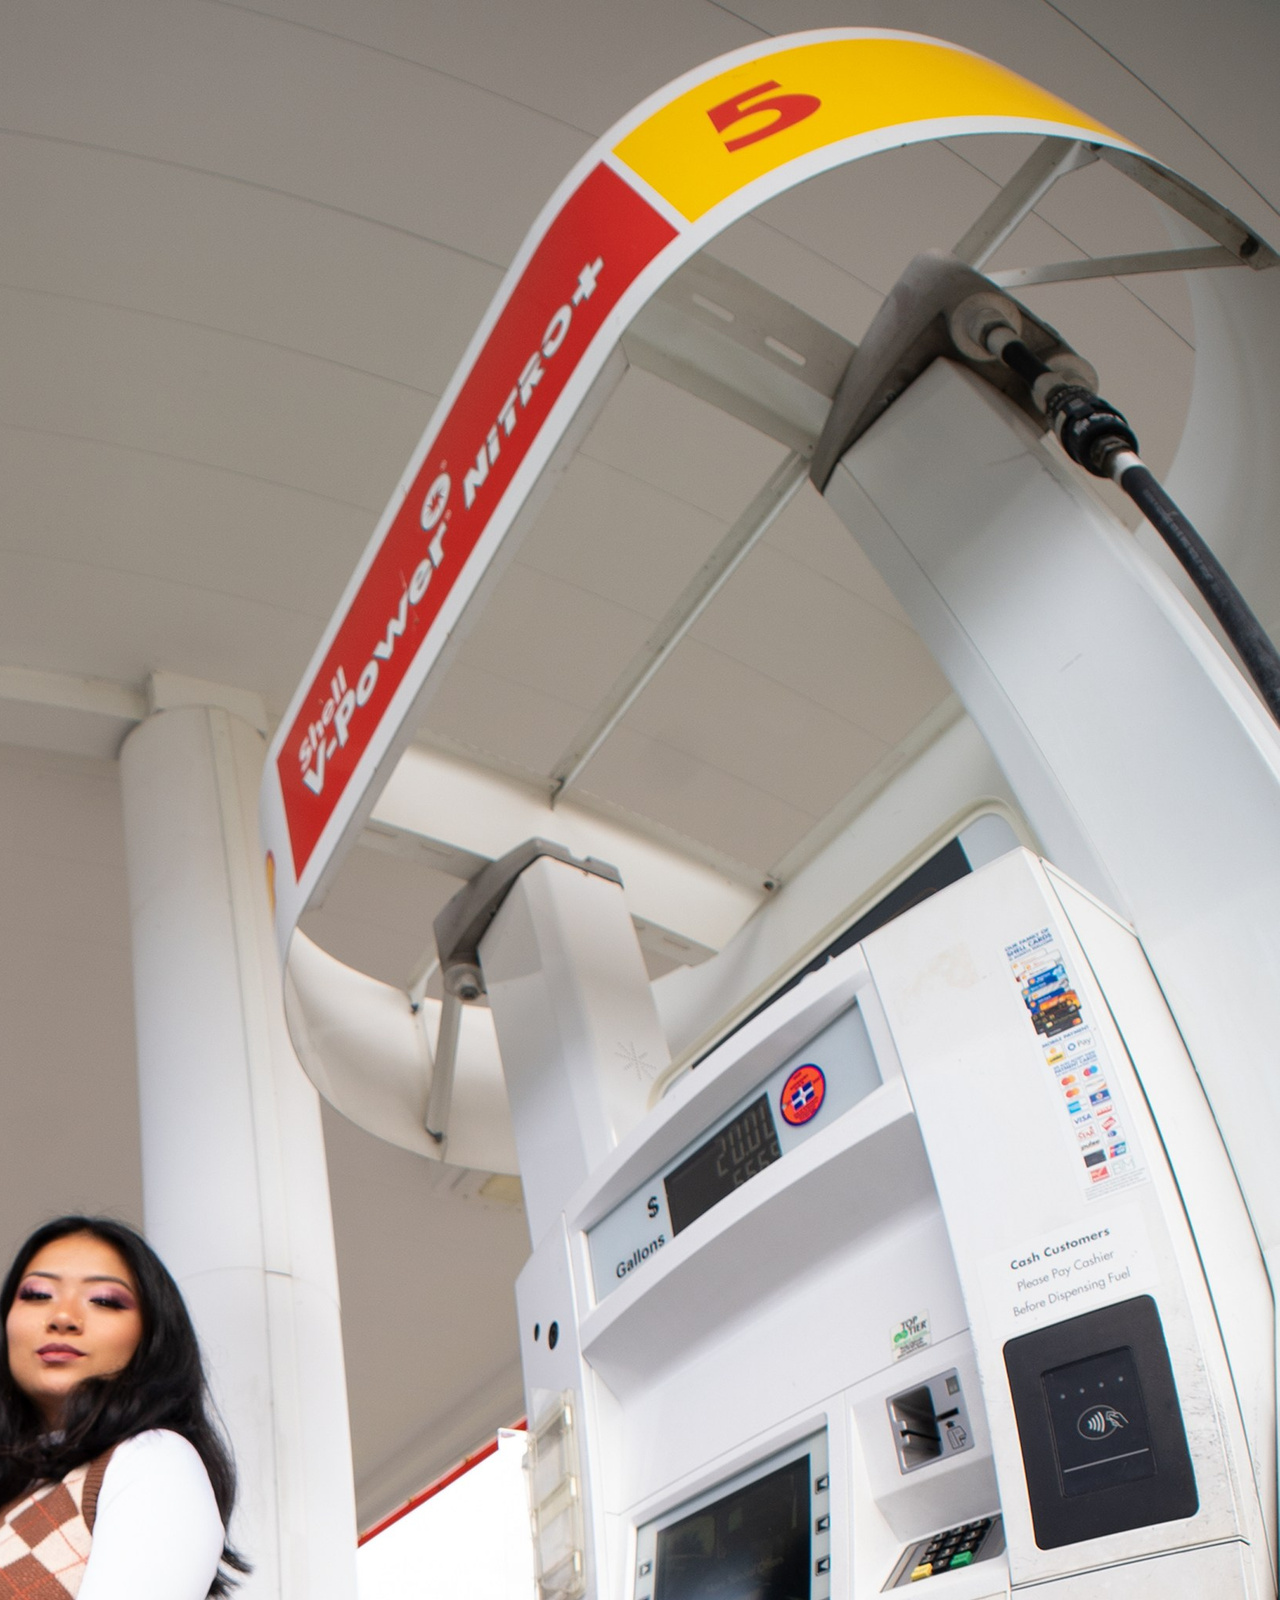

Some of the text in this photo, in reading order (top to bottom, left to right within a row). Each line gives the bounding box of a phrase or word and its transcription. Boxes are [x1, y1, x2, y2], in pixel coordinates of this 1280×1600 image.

[706, 79, 822, 153] 5
[302, 521, 449, 797] V-Power
[298, 664, 348, 774] Shell
[1074, 1113, 1093, 1125] VISA
[646, 1195, 660, 1219] $
[615, 1234, 666, 1279] Gallons
[1010, 1228, 1111, 1270] Cash Customers
[1013, 1266, 1131, 1317] Before Dispensing Fuel
[1017, 1250, 1115, 1292] Please Pay Cashier
[901, 1315, 918, 1331] TOP
